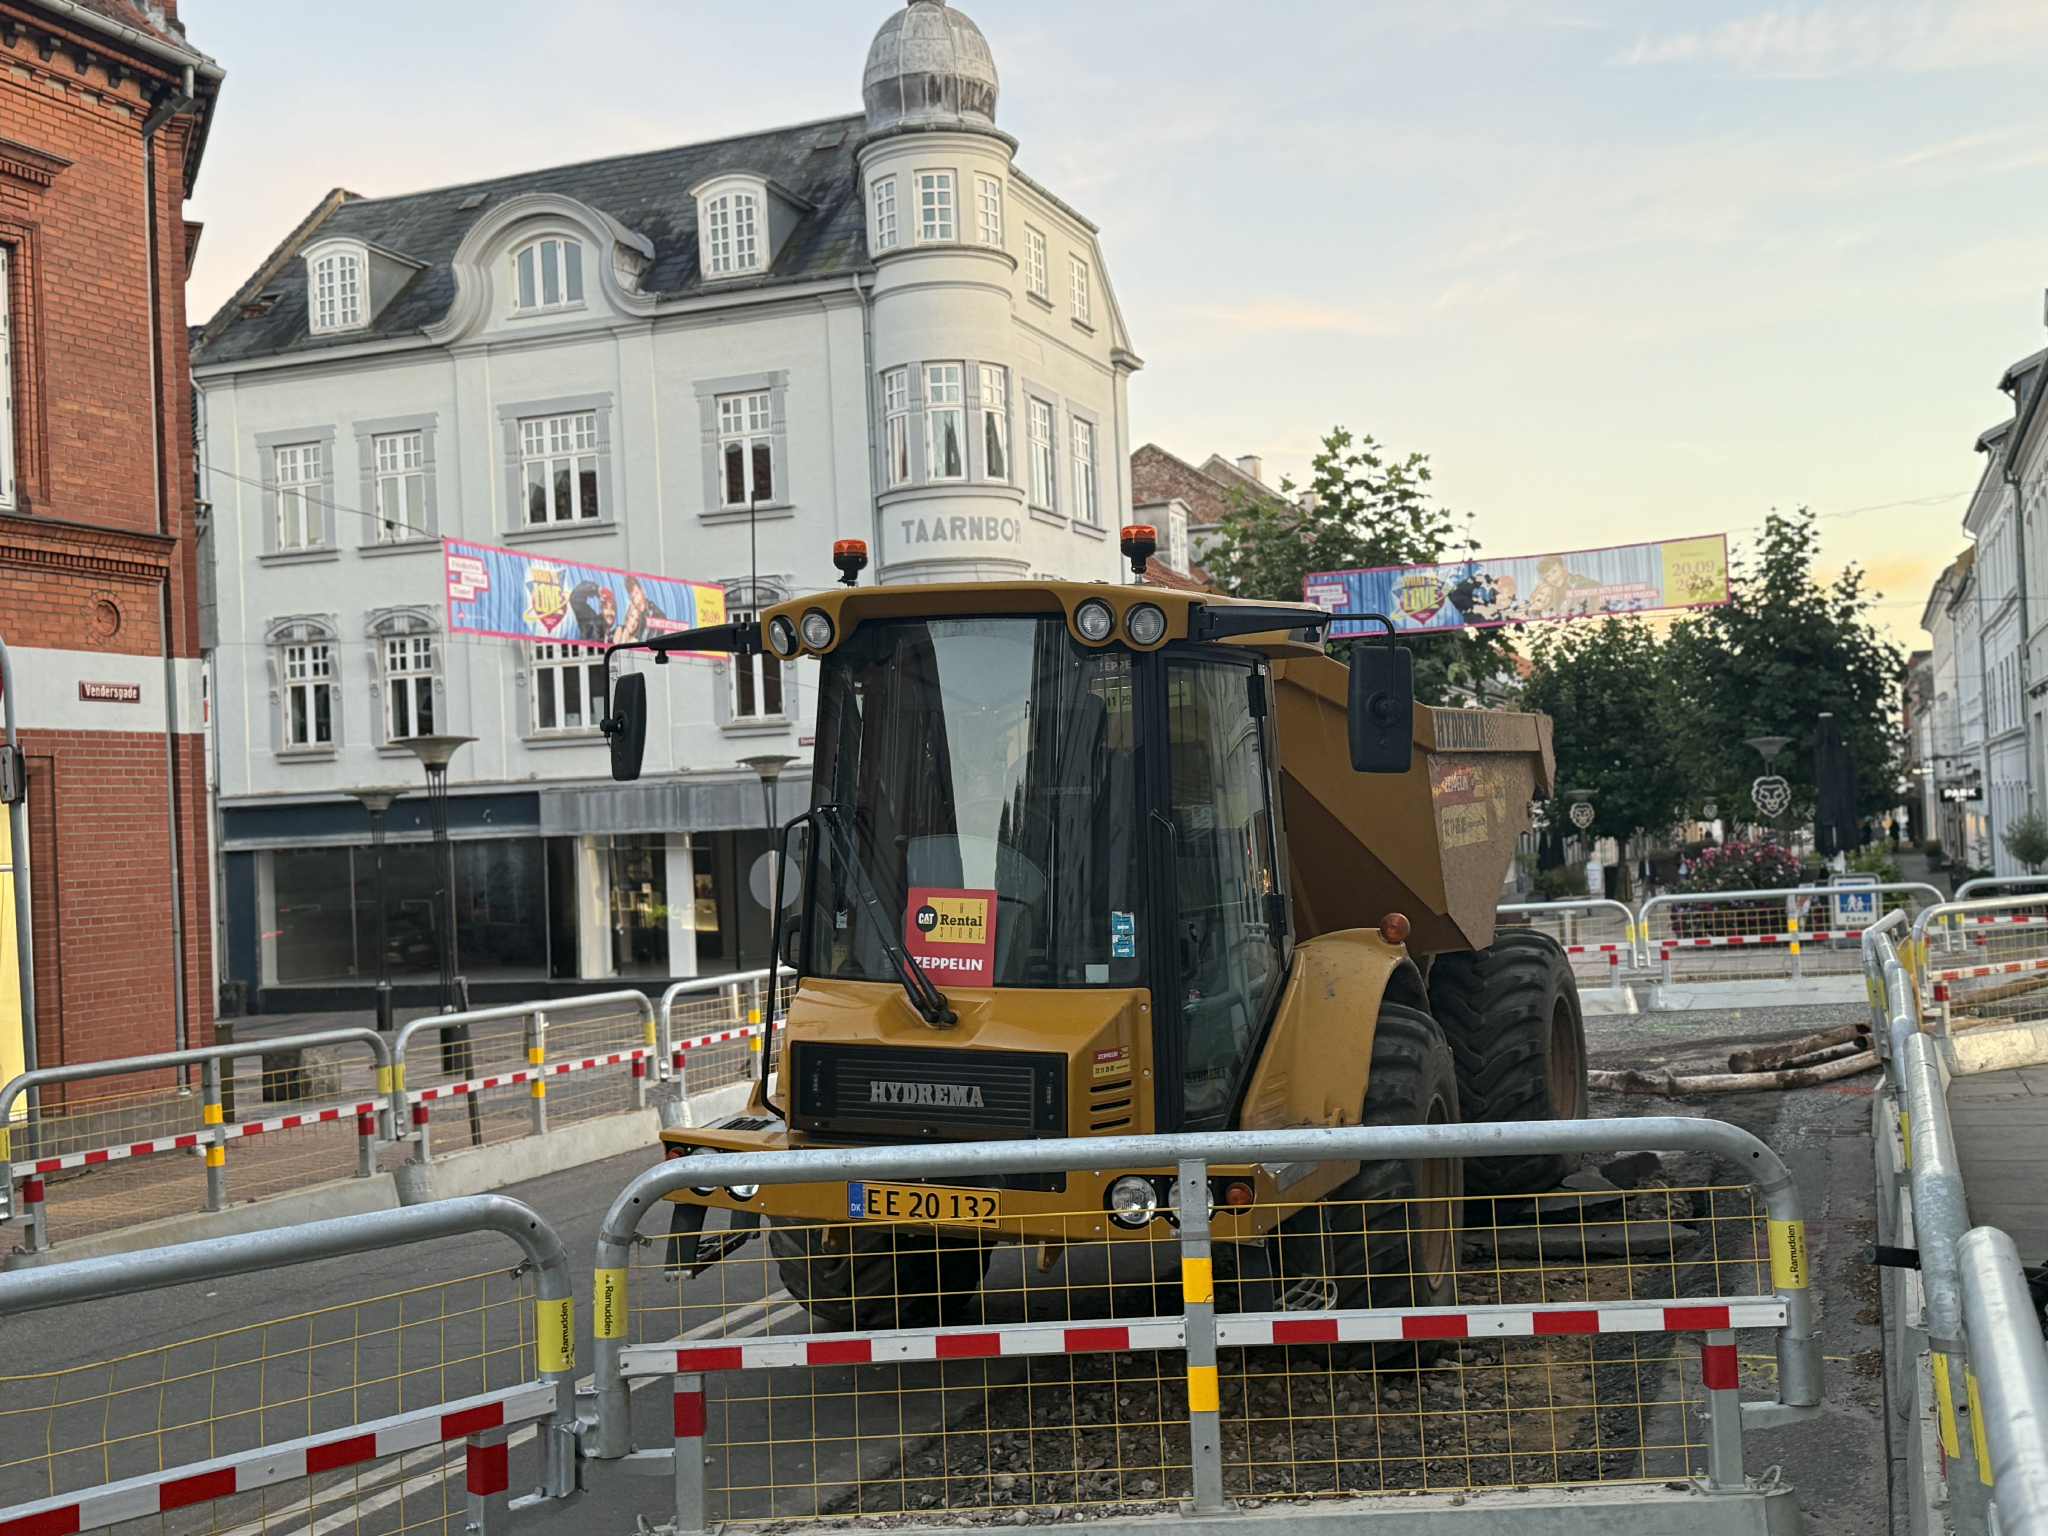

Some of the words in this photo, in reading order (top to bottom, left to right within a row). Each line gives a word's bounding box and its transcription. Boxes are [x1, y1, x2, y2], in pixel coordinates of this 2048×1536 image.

[1403, 586, 1440, 612] LOVE
[1437, 711, 1489, 748] HYDREMA
[1944, 788, 1976, 798] PARK
[918, 912, 934, 925] CAT
[940, 913, 983, 927] Rental
[913, 956, 983, 971] ZEPPELIN
[870, 1081, 985, 1107] HYDREMA
[850, 1203, 861, 1212] DK
[867, 1188, 900, 1216] EE
[908, 1191, 940, 1219] 20
[950, 1195, 996, 1224] 132
[1787, 1224, 1799, 1273] Ramudden
[604, 1285, 614, 1336] Ramudden
[560, 1302, 569, 1354] Ramudden
